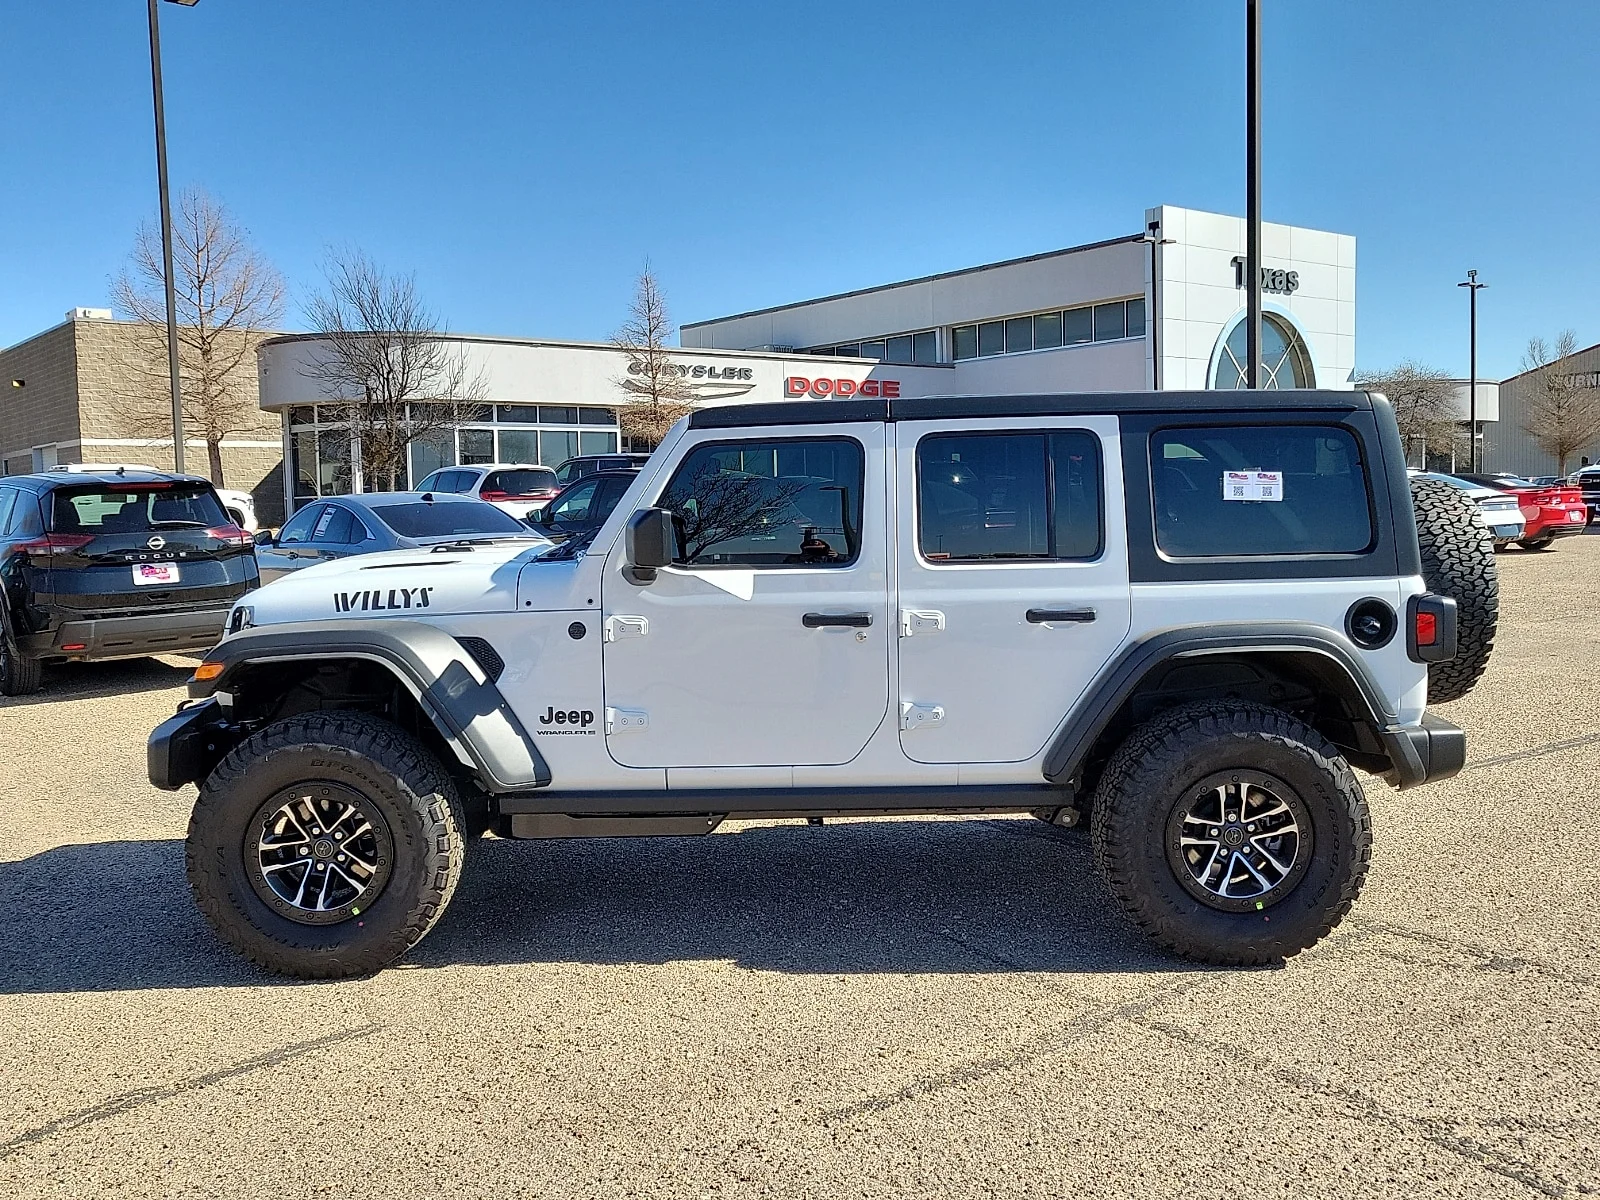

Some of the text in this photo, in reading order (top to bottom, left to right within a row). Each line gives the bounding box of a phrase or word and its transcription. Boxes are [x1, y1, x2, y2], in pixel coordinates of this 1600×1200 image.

[1230, 256, 1299, 295] Txas
[787, 376, 901, 398] DODGE
[125, 551, 187, 560] ROGUE
[334, 587, 433, 612] WILLYS
[540, 707, 594, 727] Jeep
